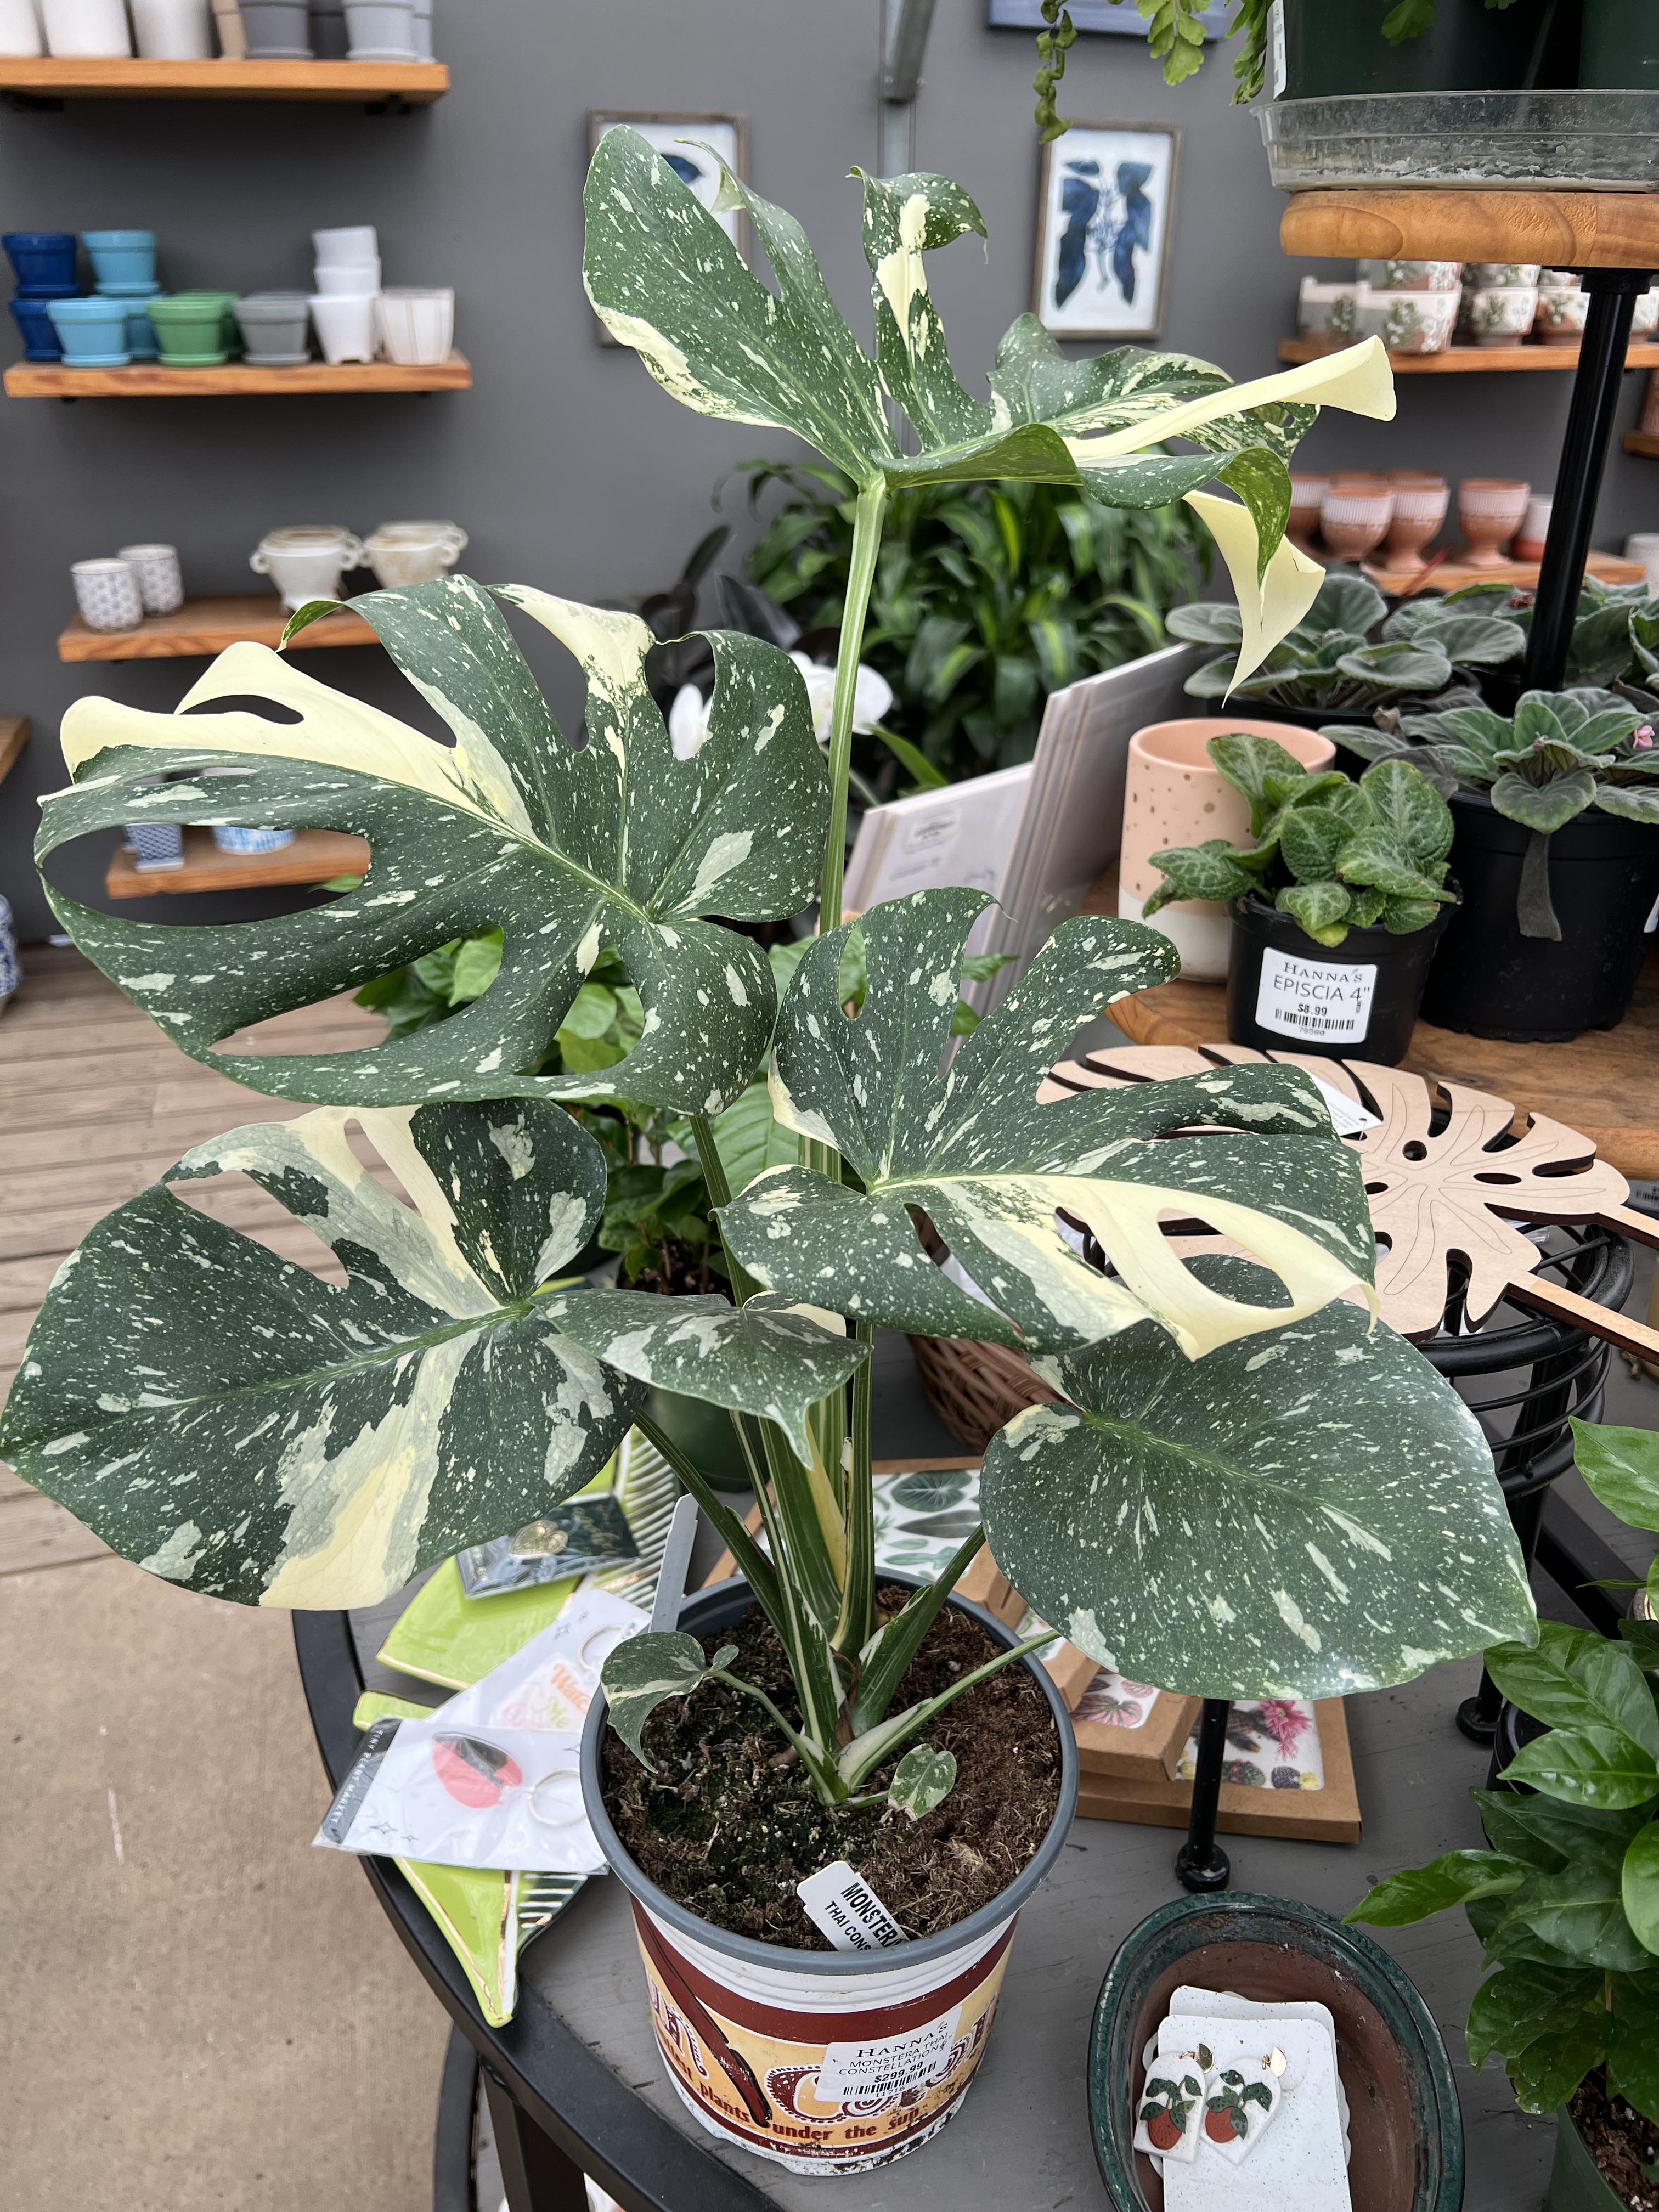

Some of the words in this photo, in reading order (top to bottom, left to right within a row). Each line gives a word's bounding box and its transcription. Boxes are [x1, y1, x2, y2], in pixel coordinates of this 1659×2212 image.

[1284, 961, 1363, 983] HANNA'S
[1274, 974, 1344, 1001] EPISCIA
[1349, 987, 1370, 1000] 4"
[1297, 1003, 1328, 1017] $8.99
[368, 1729, 383, 1751] TINY
[353, 1752, 372, 1782] PLANT
[331, 1784, 356, 1824] MARKET
[825, 1900, 850, 1928] THAI
[850, 2048, 920, 2068] MONSTERA
[924, 2032, 949, 2050] THAI
[856, 2021, 948, 2058] HANNA'S
[839, 2044, 940, 2075] CONSTELLATION
[873, 2061, 924, 2083] $299.99
[700, 2082, 751, 2123] plants
[772, 2123, 834, 2140] under
[844, 2125, 877, 2140] the
